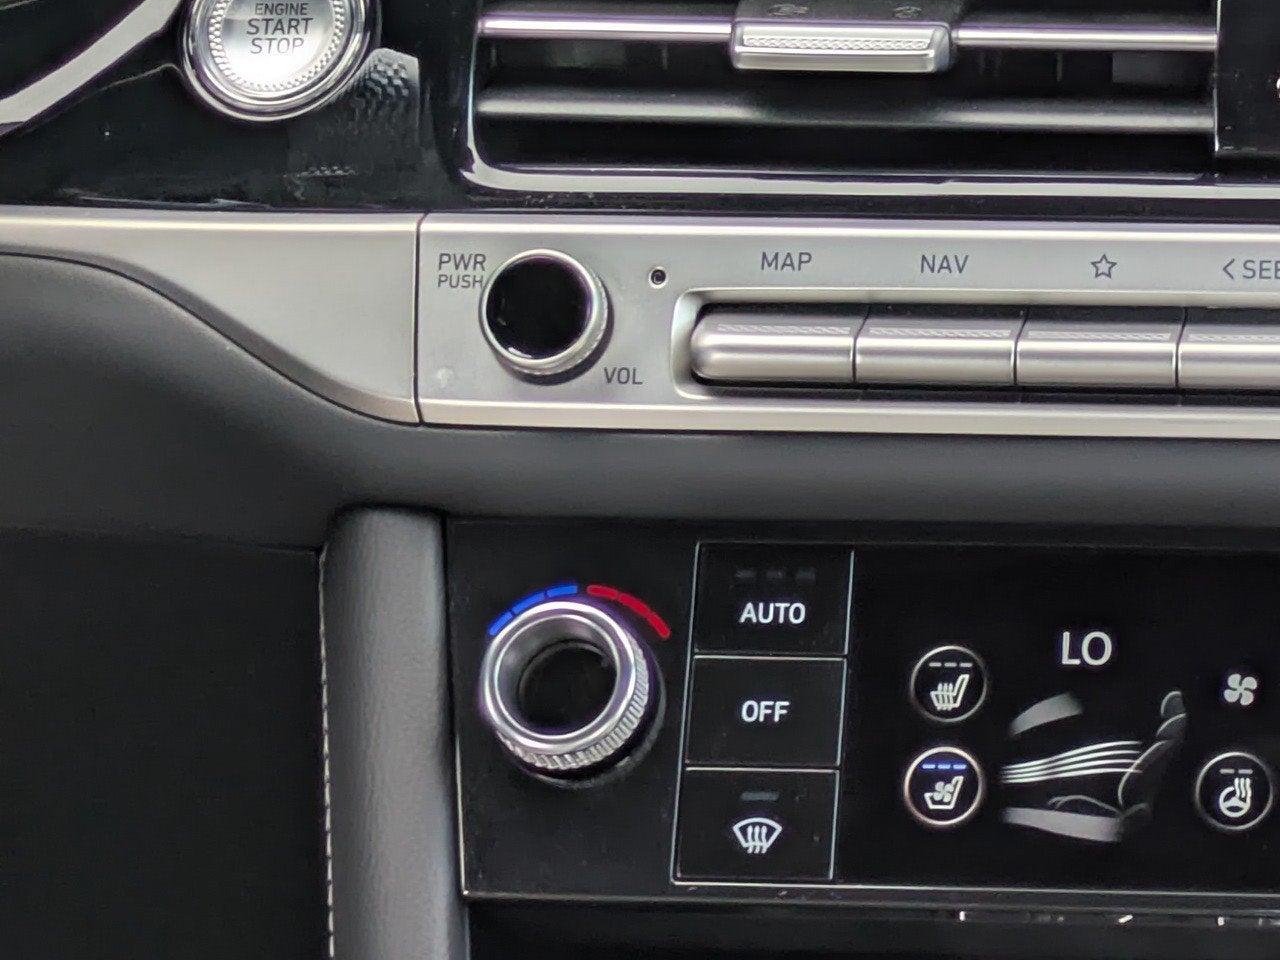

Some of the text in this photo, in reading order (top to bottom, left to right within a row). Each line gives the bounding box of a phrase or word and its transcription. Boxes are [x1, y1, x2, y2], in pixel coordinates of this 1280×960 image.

[254, 2, 309, 16] ENGINE
[246, 17, 314, 35] START
[249, 37, 305, 55] STOP
[437, 253, 486, 272] PWR
[760, 251, 812, 272] MAP
[919, 254, 970, 274] NAV
[437, 274, 484, 289] PUSH
[603, 367, 643, 385] VOL
[738, 602, 806, 625] AUTO
[1061, 631, 1113, 666] LO
[741, 700, 790, 723] OFF
